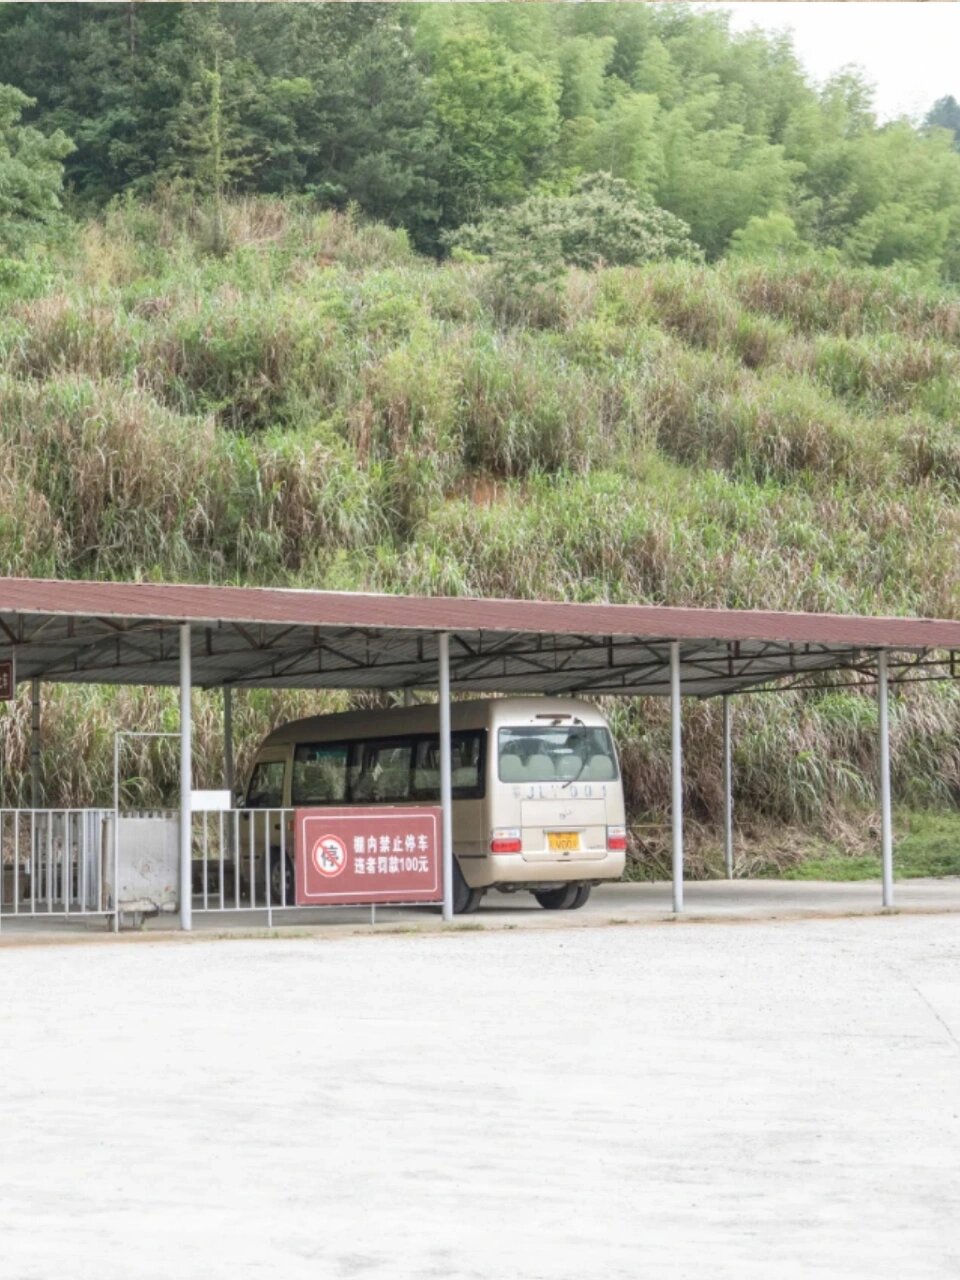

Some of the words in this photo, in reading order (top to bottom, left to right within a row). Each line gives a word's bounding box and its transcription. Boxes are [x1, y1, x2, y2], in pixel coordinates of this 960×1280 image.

[354, 856, 429, 874] 违者罚款100元
